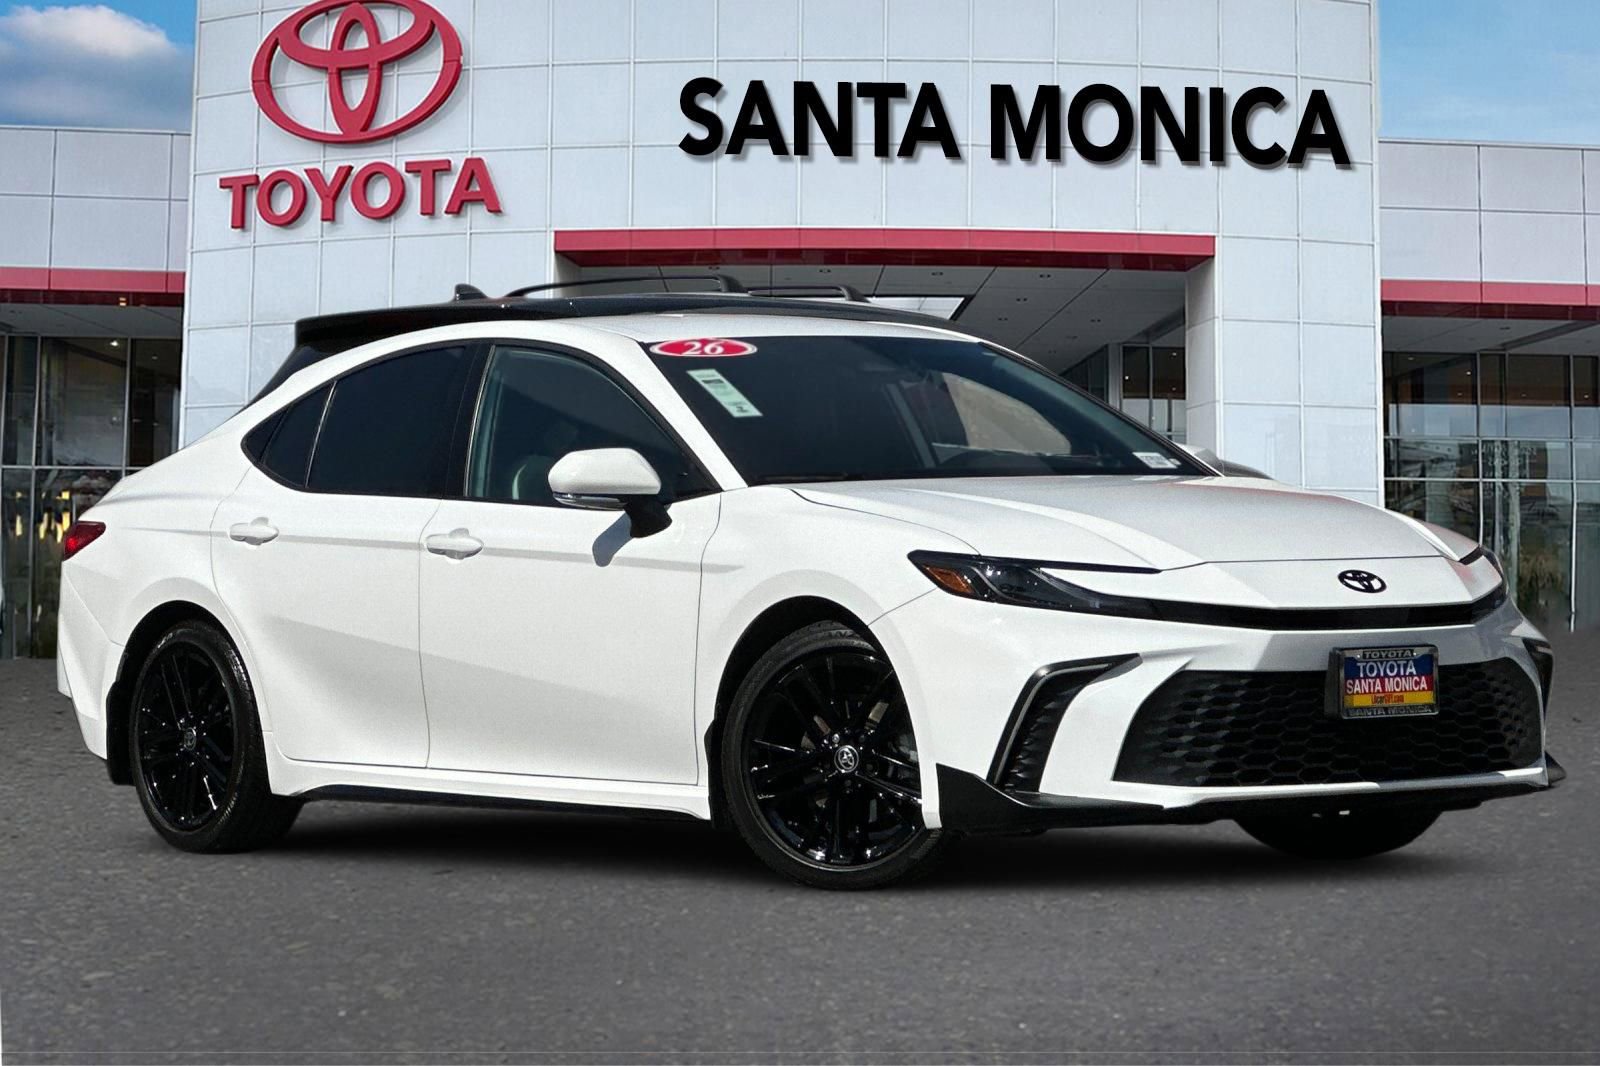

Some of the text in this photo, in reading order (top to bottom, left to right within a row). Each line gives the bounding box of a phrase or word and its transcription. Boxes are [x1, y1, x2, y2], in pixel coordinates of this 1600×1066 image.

[679, 77, 1352, 168] SANTA MONICA
[219, 157, 503, 230] TOYOTA
[680, 341, 725, 355] 26
[1364, 650, 1412, 659] TOYOTA
[1356, 660, 1417, 677] TOYOTA
[1346, 676, 1428, 694] SANTA MONICA
[1349, 704, 1432, 716] SANTA MONICA
